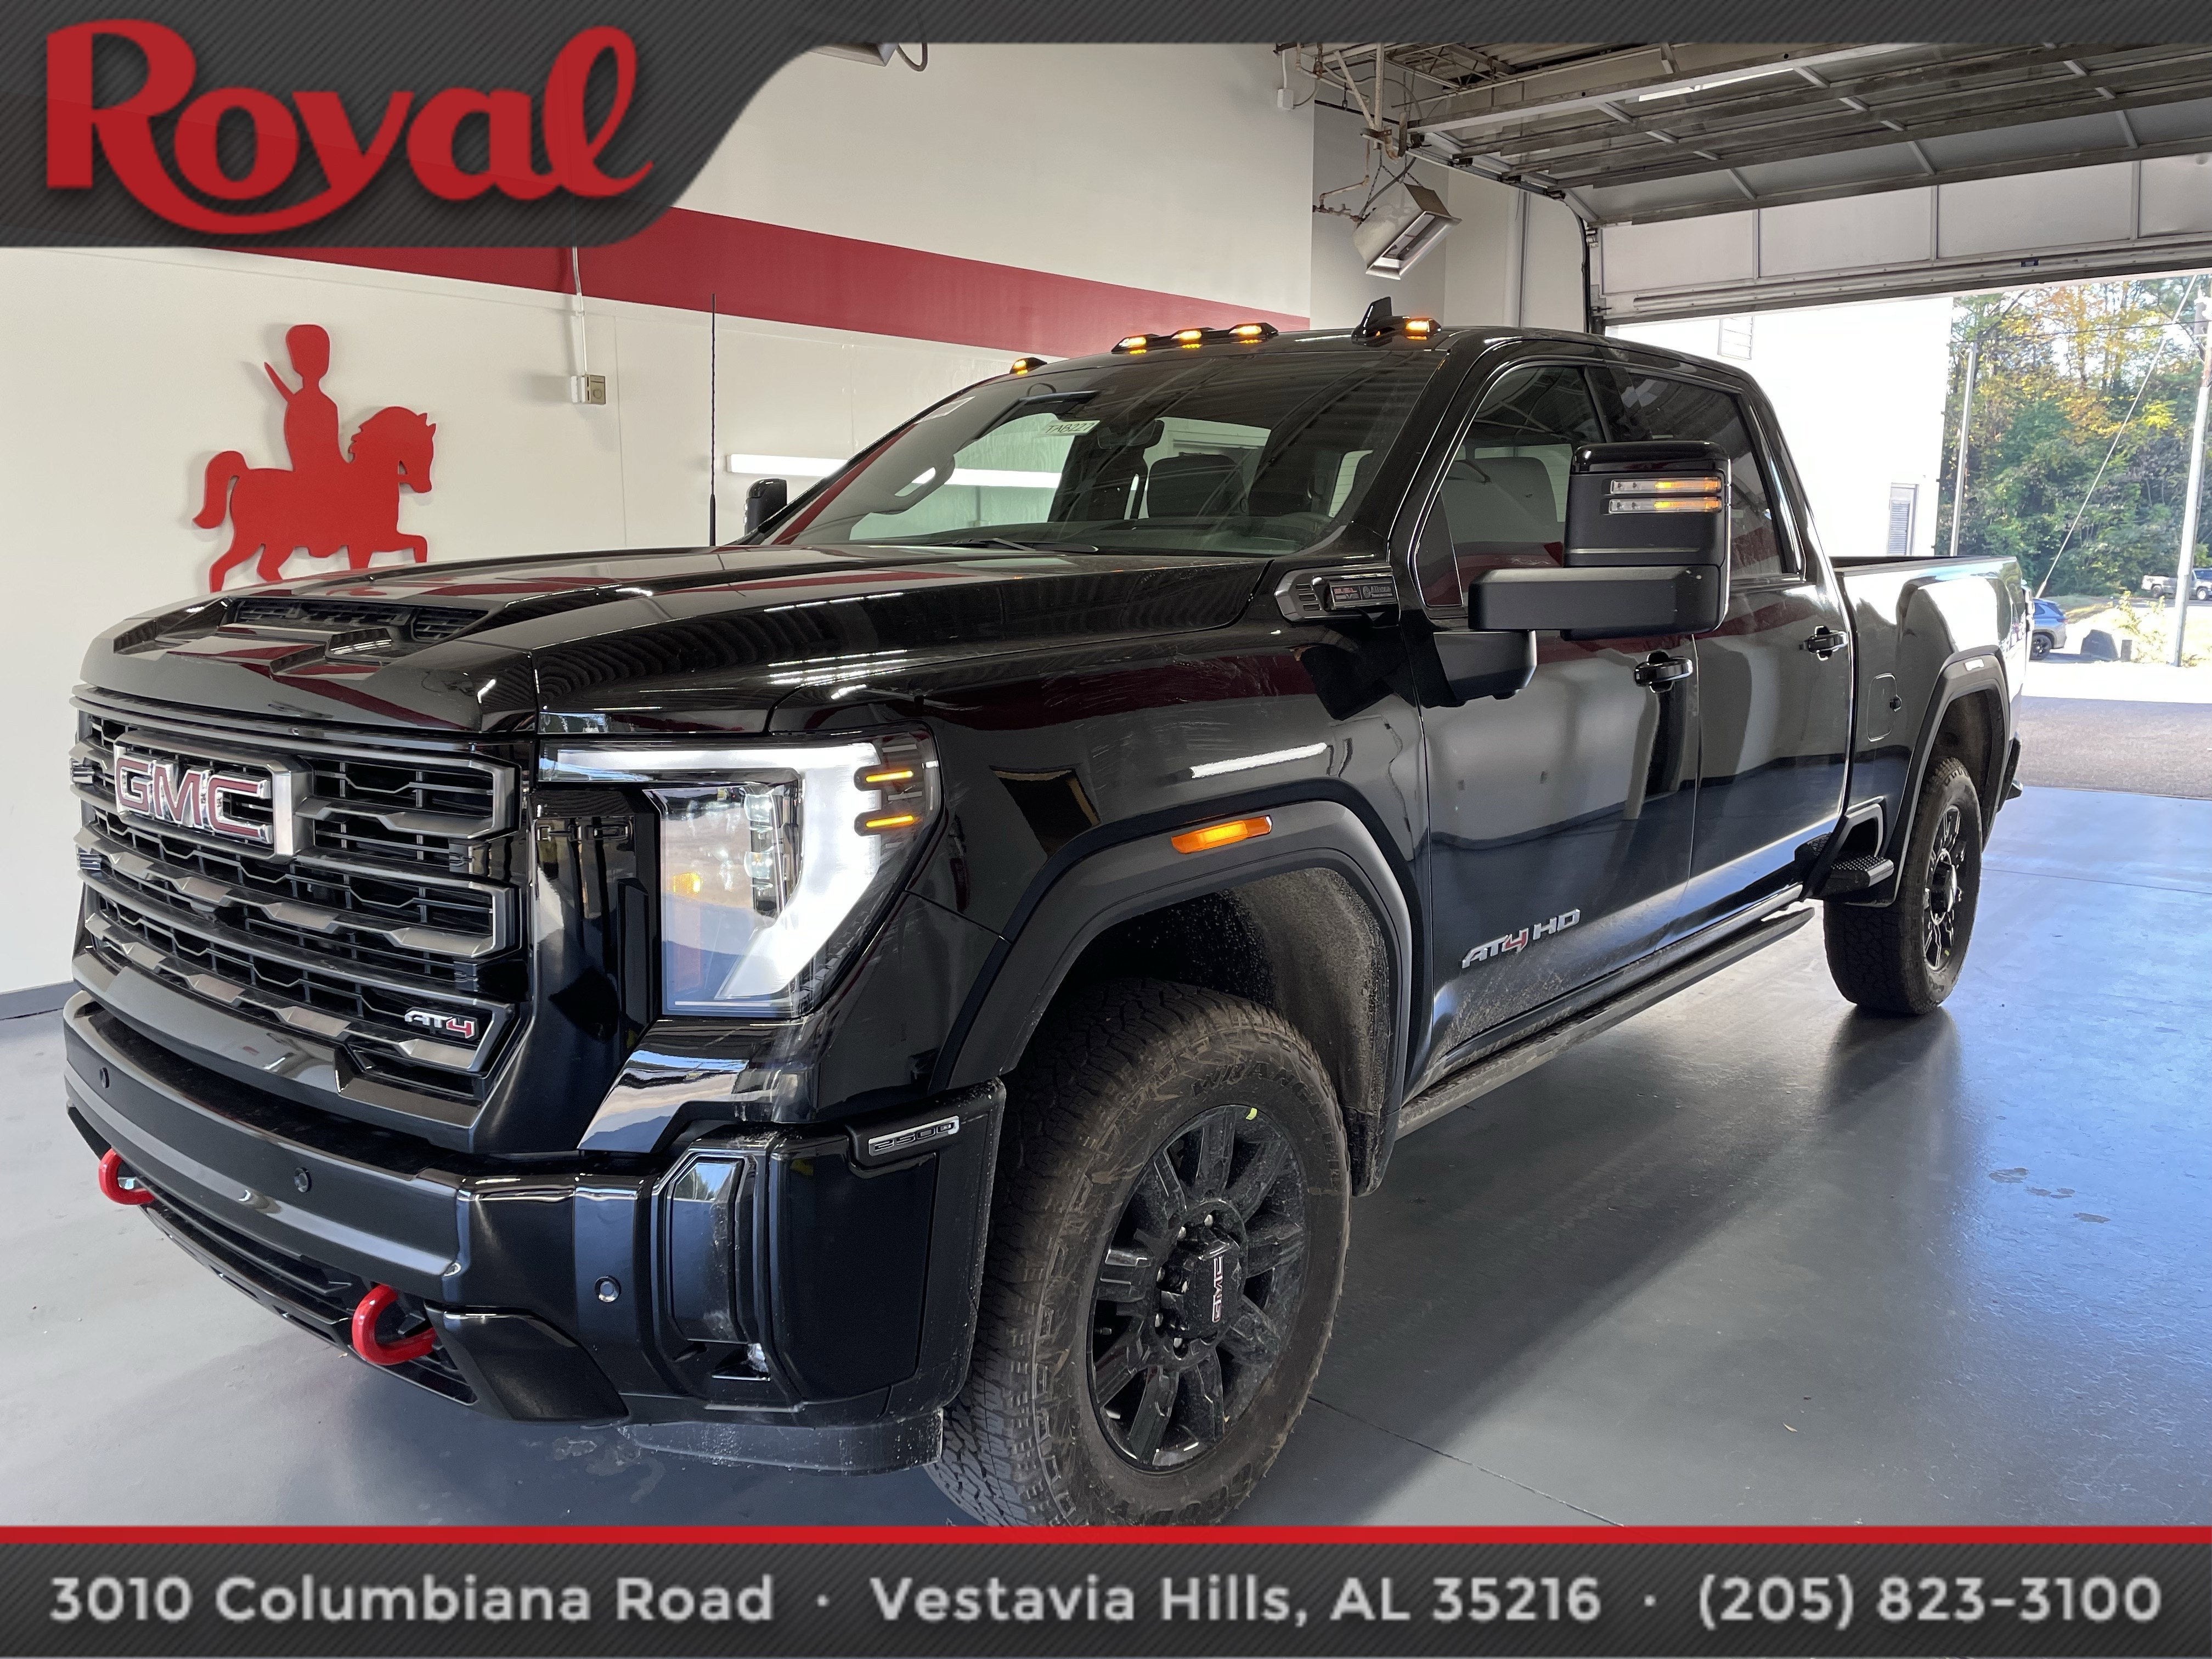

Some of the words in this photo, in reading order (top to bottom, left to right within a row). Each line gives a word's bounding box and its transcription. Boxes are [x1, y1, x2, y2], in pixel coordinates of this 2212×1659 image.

[1045, 422, 1096, 433] TAB227
[116, 754, 273, 844] GMC
[1462, 928, 1529, 969] AT4
[1533, 909, 1581, 940] HD
[404, 1010, 475, 1039] AT4
[873, 1121, 955, 1152] 2500
[1211, 1256, 1224, 1323] GMC
